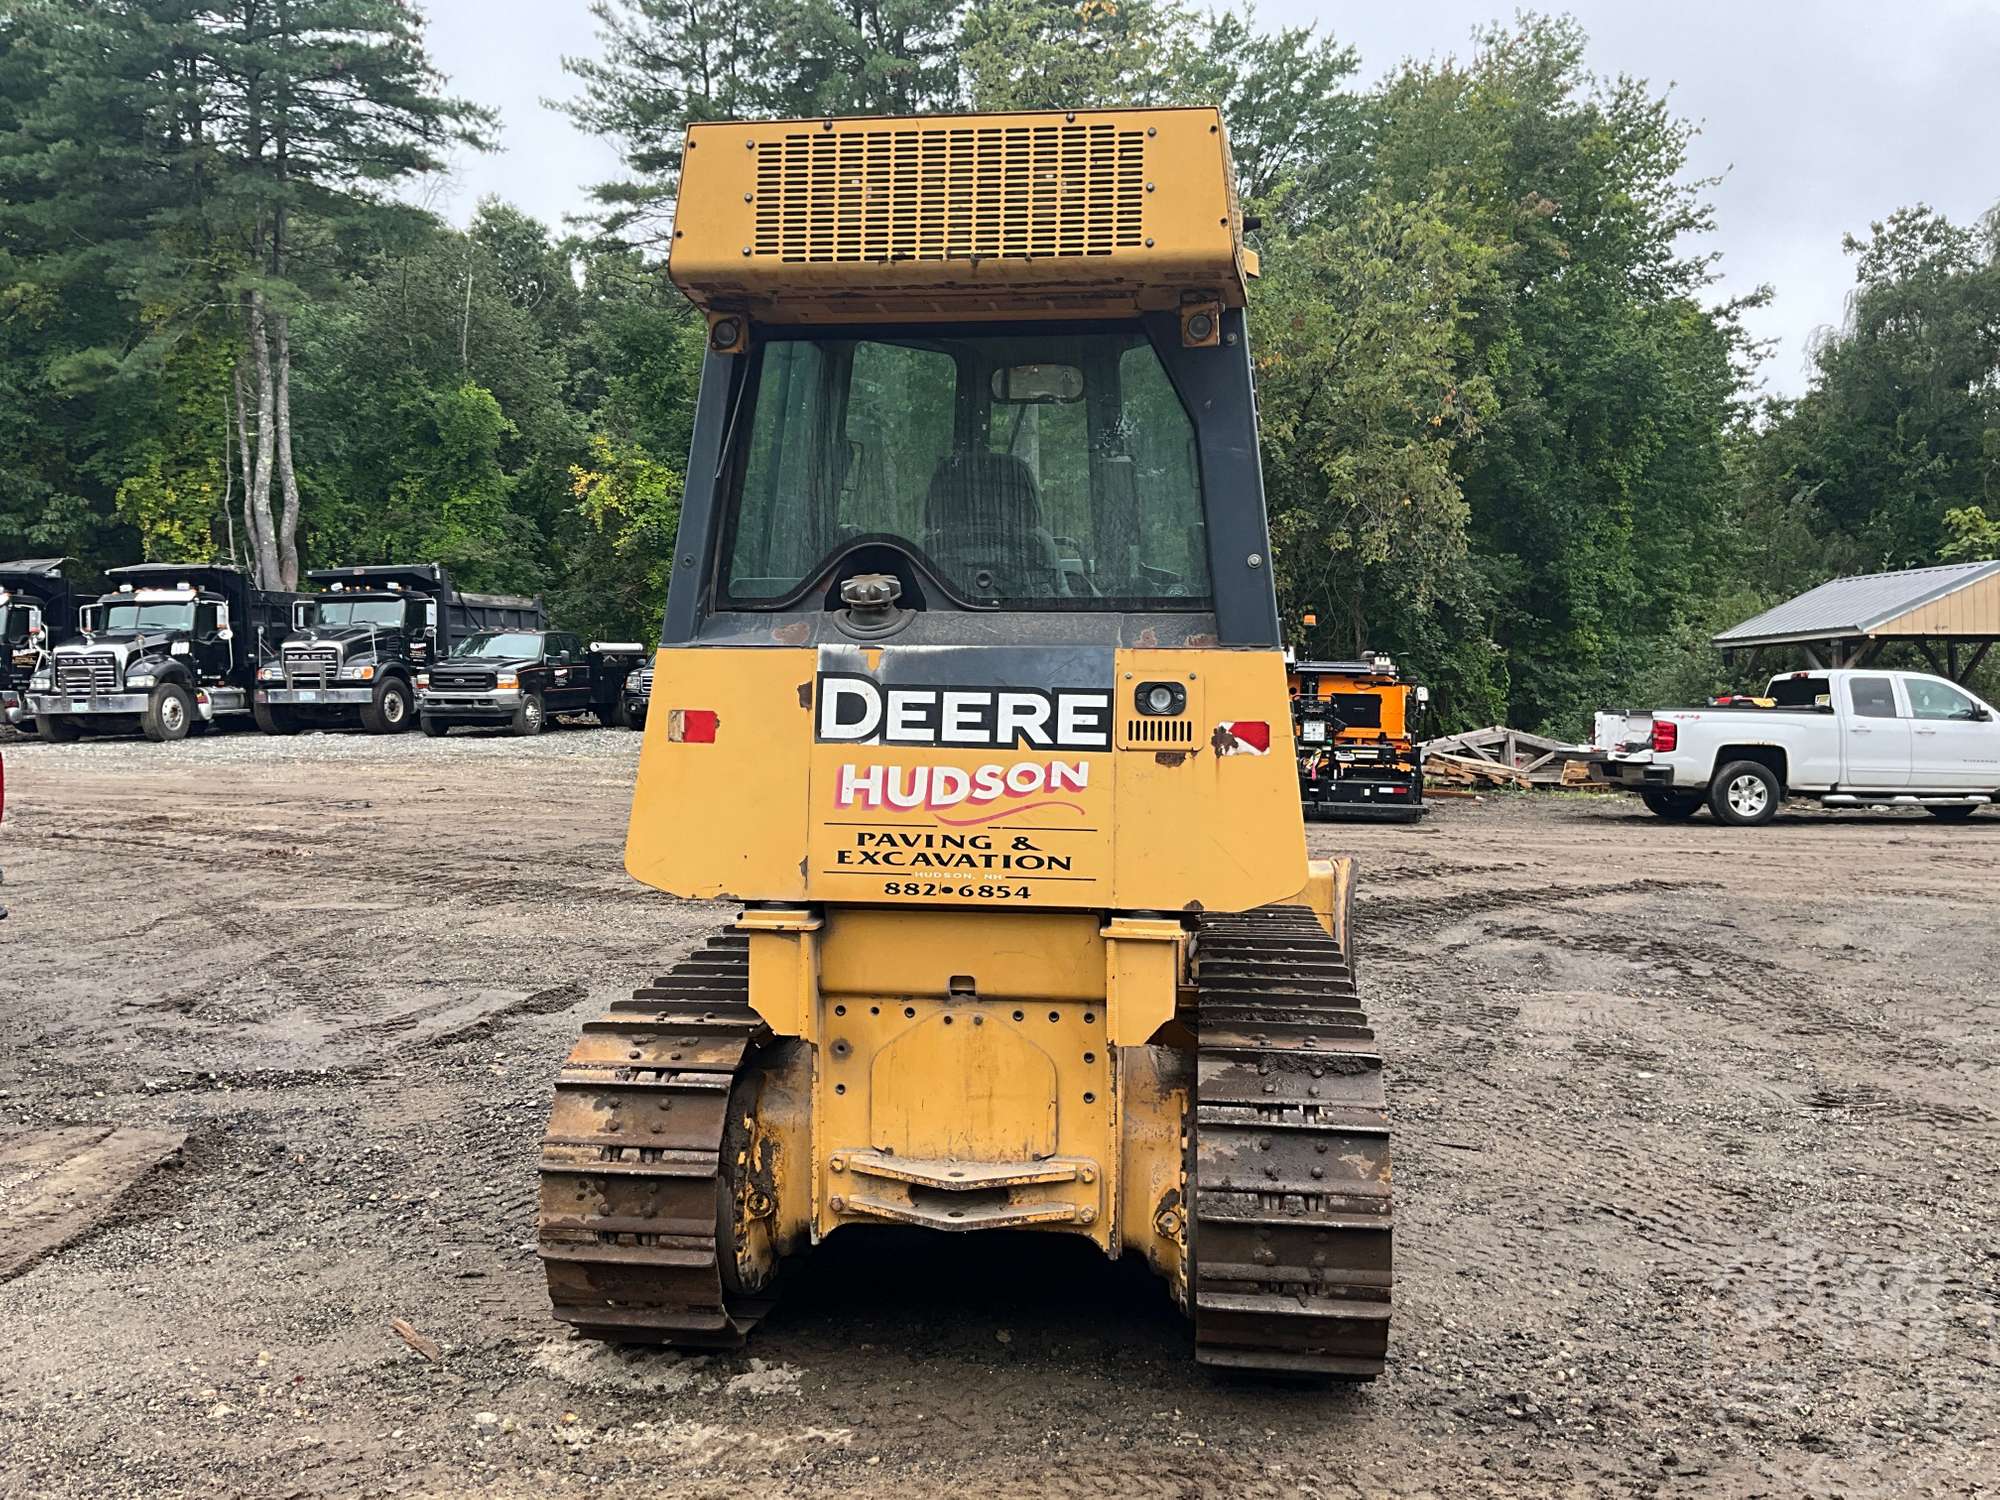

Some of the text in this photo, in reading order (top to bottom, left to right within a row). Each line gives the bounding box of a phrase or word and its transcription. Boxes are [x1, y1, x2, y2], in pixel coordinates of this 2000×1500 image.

[820, 678, 1108, 745] DEERE
[836, 761, 1089, 810] HUDSON
[857, 832, 1044, 851] PAVING &
[836, 850, 1072, 871] EXCAVATION
